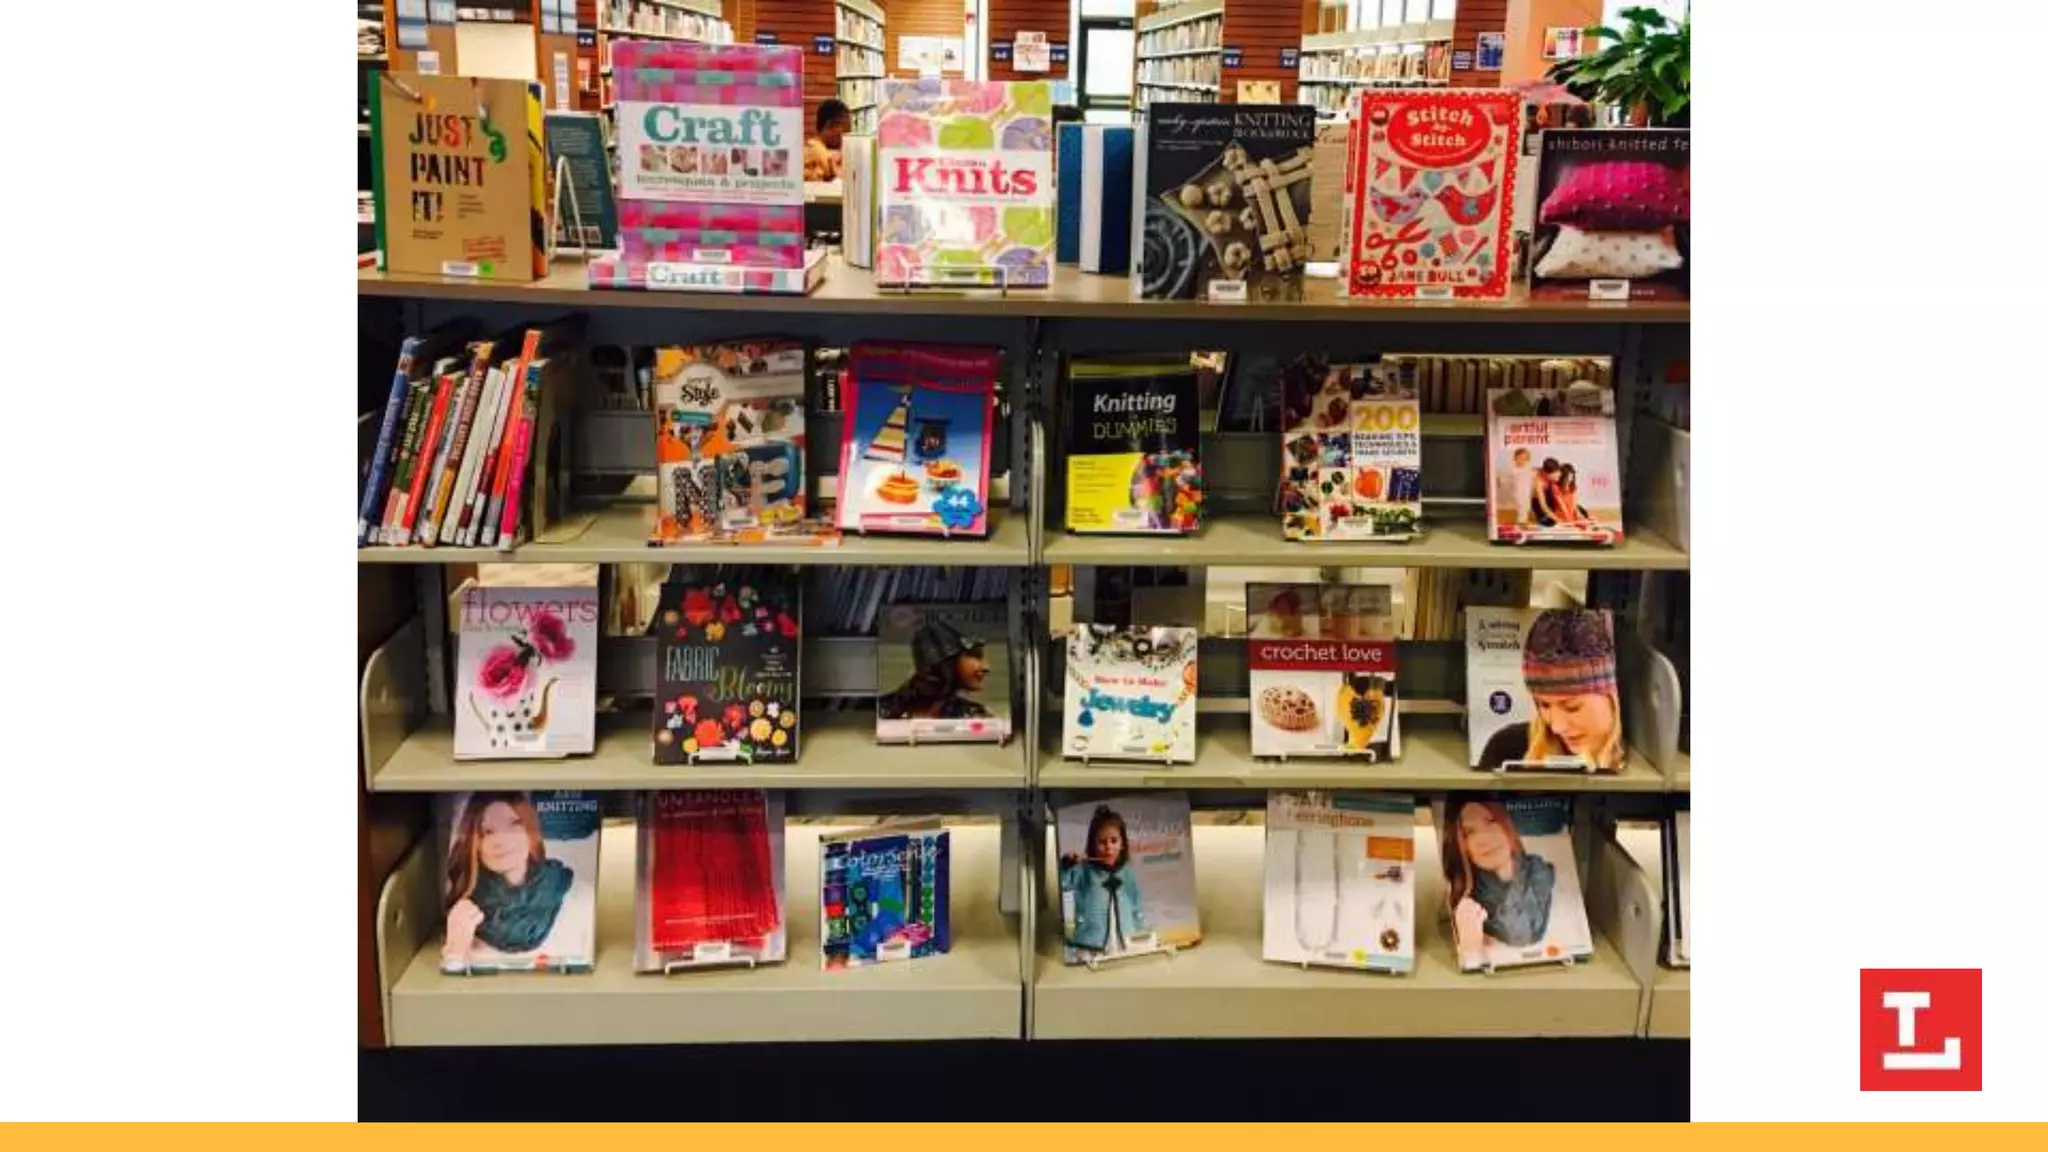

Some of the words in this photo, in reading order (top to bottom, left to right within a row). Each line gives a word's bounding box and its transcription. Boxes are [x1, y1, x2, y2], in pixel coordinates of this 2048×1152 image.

[643, 104, 781, 146] Craft
[1234, 112, 1311, 127] KNITTING
[1406, 105, 1473, 127] Stitch
[409, 112, 476, 149] JUST
[1411, 132, 1468, 148] Stitch
[411, 152, 486, 187] PAINT
[893, 156, 1038, 196] Knits
[412, 190, 445, 222] IT!
[651, 266, 721, 285] Craft
[681, 383, 720, 407] Style
[1093, 392, 1177, 413] Knitting
[1092, 418, 1177, 439] DUMMIES
[1355, 405, 1417, 432] 200
[461, 587, 598, 624] flowers
[665, 646, 720, 681] FABRIC
[1260, 644, 1338, 662] crochet
[1343, 645, 1382, 662] love
[536, 800, 598, 813] KNITTING
